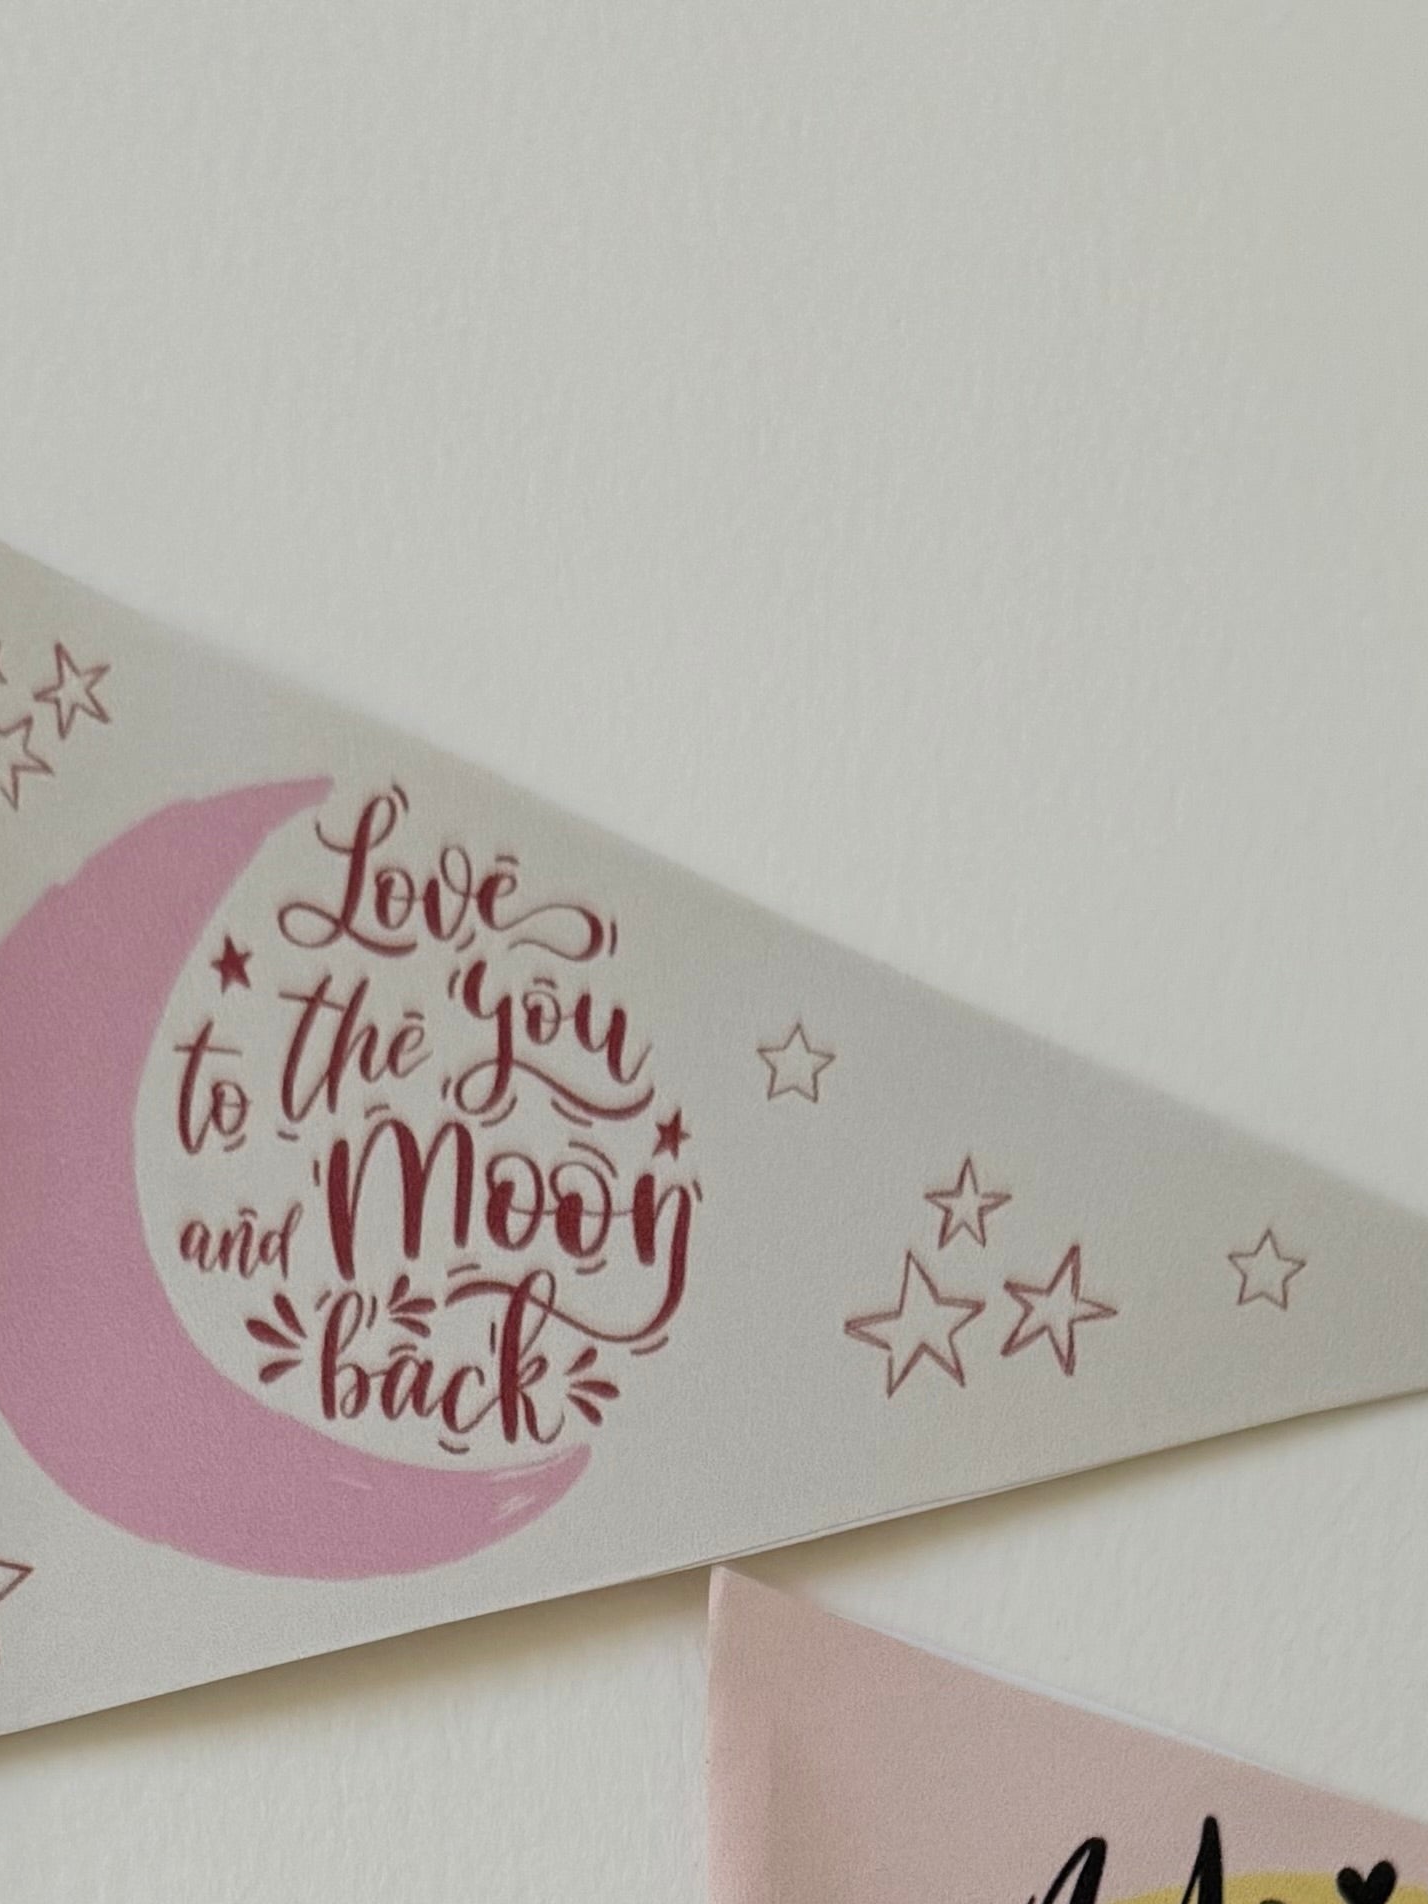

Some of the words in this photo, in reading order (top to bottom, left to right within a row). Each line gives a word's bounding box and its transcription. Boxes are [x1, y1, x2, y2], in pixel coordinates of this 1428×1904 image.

[277, 796, 603, 960] Love
[174, 1019, 249, 1155] to
[278, 974, 432, 1123] the
[178, 1203, 303, 1279] and
[327, 1118, 691, 1341] Moon
[321, 1269, 565, 1445] back
